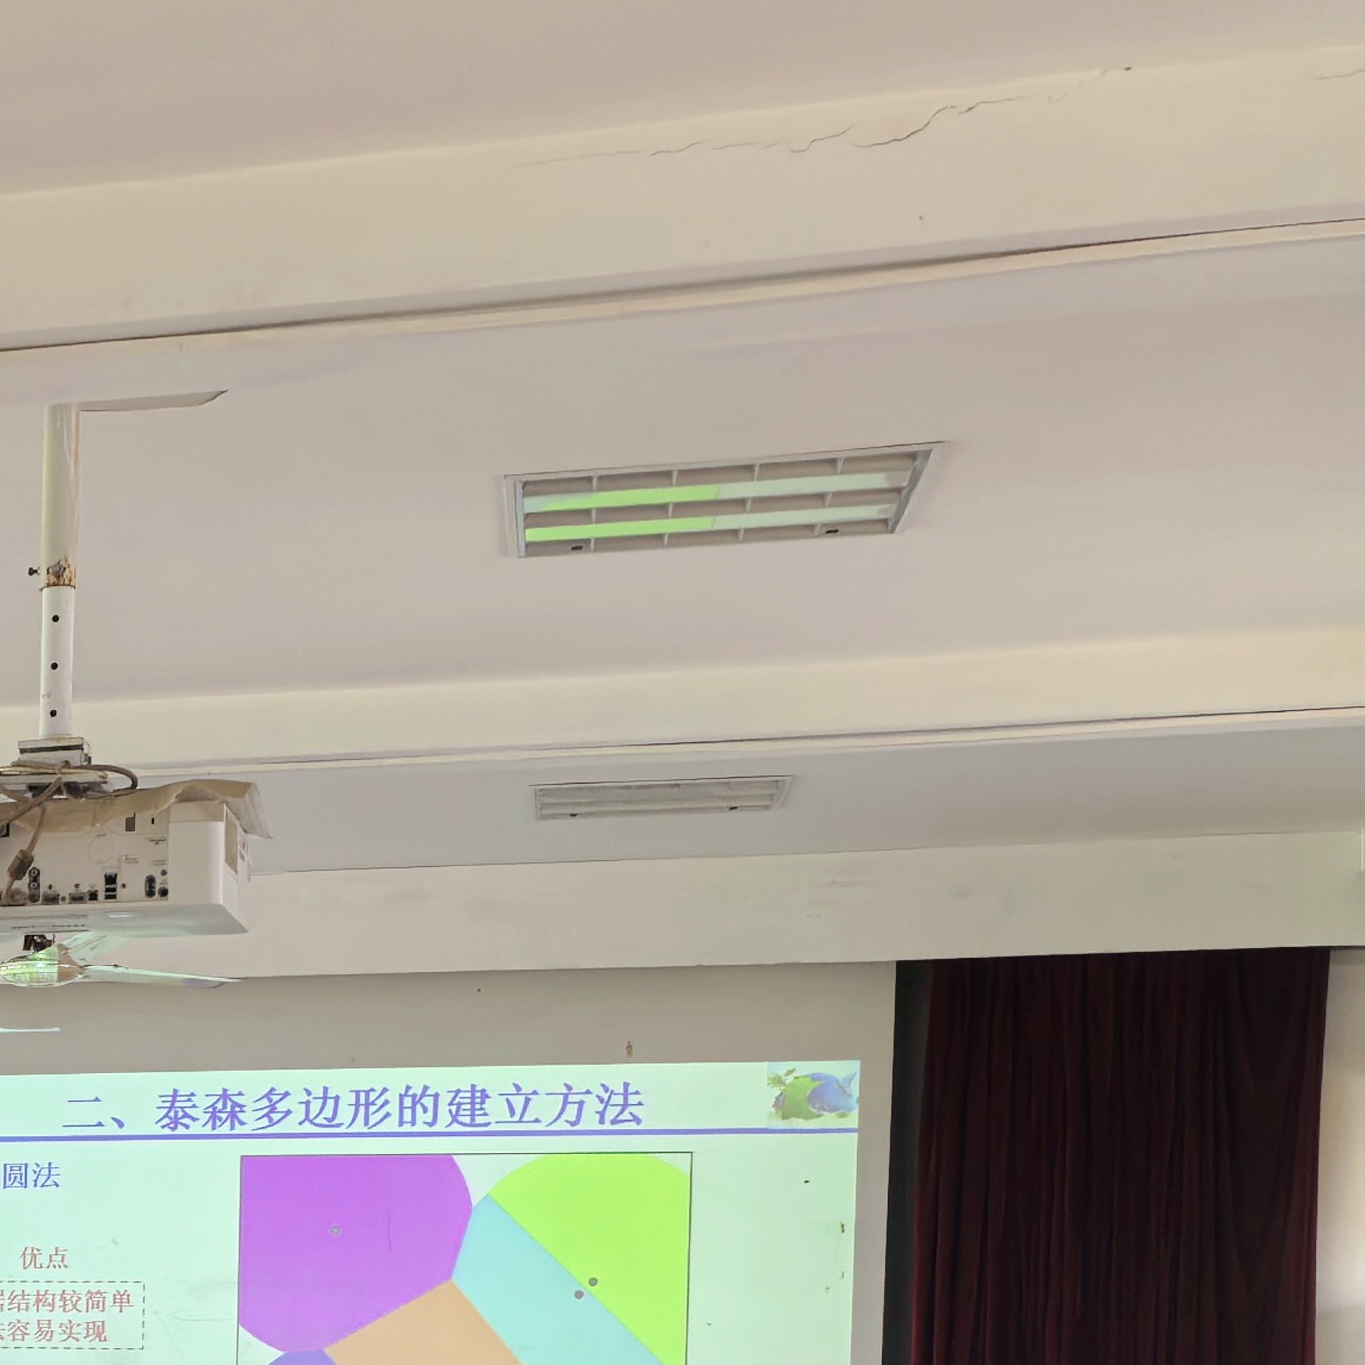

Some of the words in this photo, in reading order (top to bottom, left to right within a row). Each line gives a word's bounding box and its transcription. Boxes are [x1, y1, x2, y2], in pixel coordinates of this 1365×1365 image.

[62, 1081, 644, 1132] 二、泰森多边形的建立方法
[20, 1246, 70, 1270] 优点
